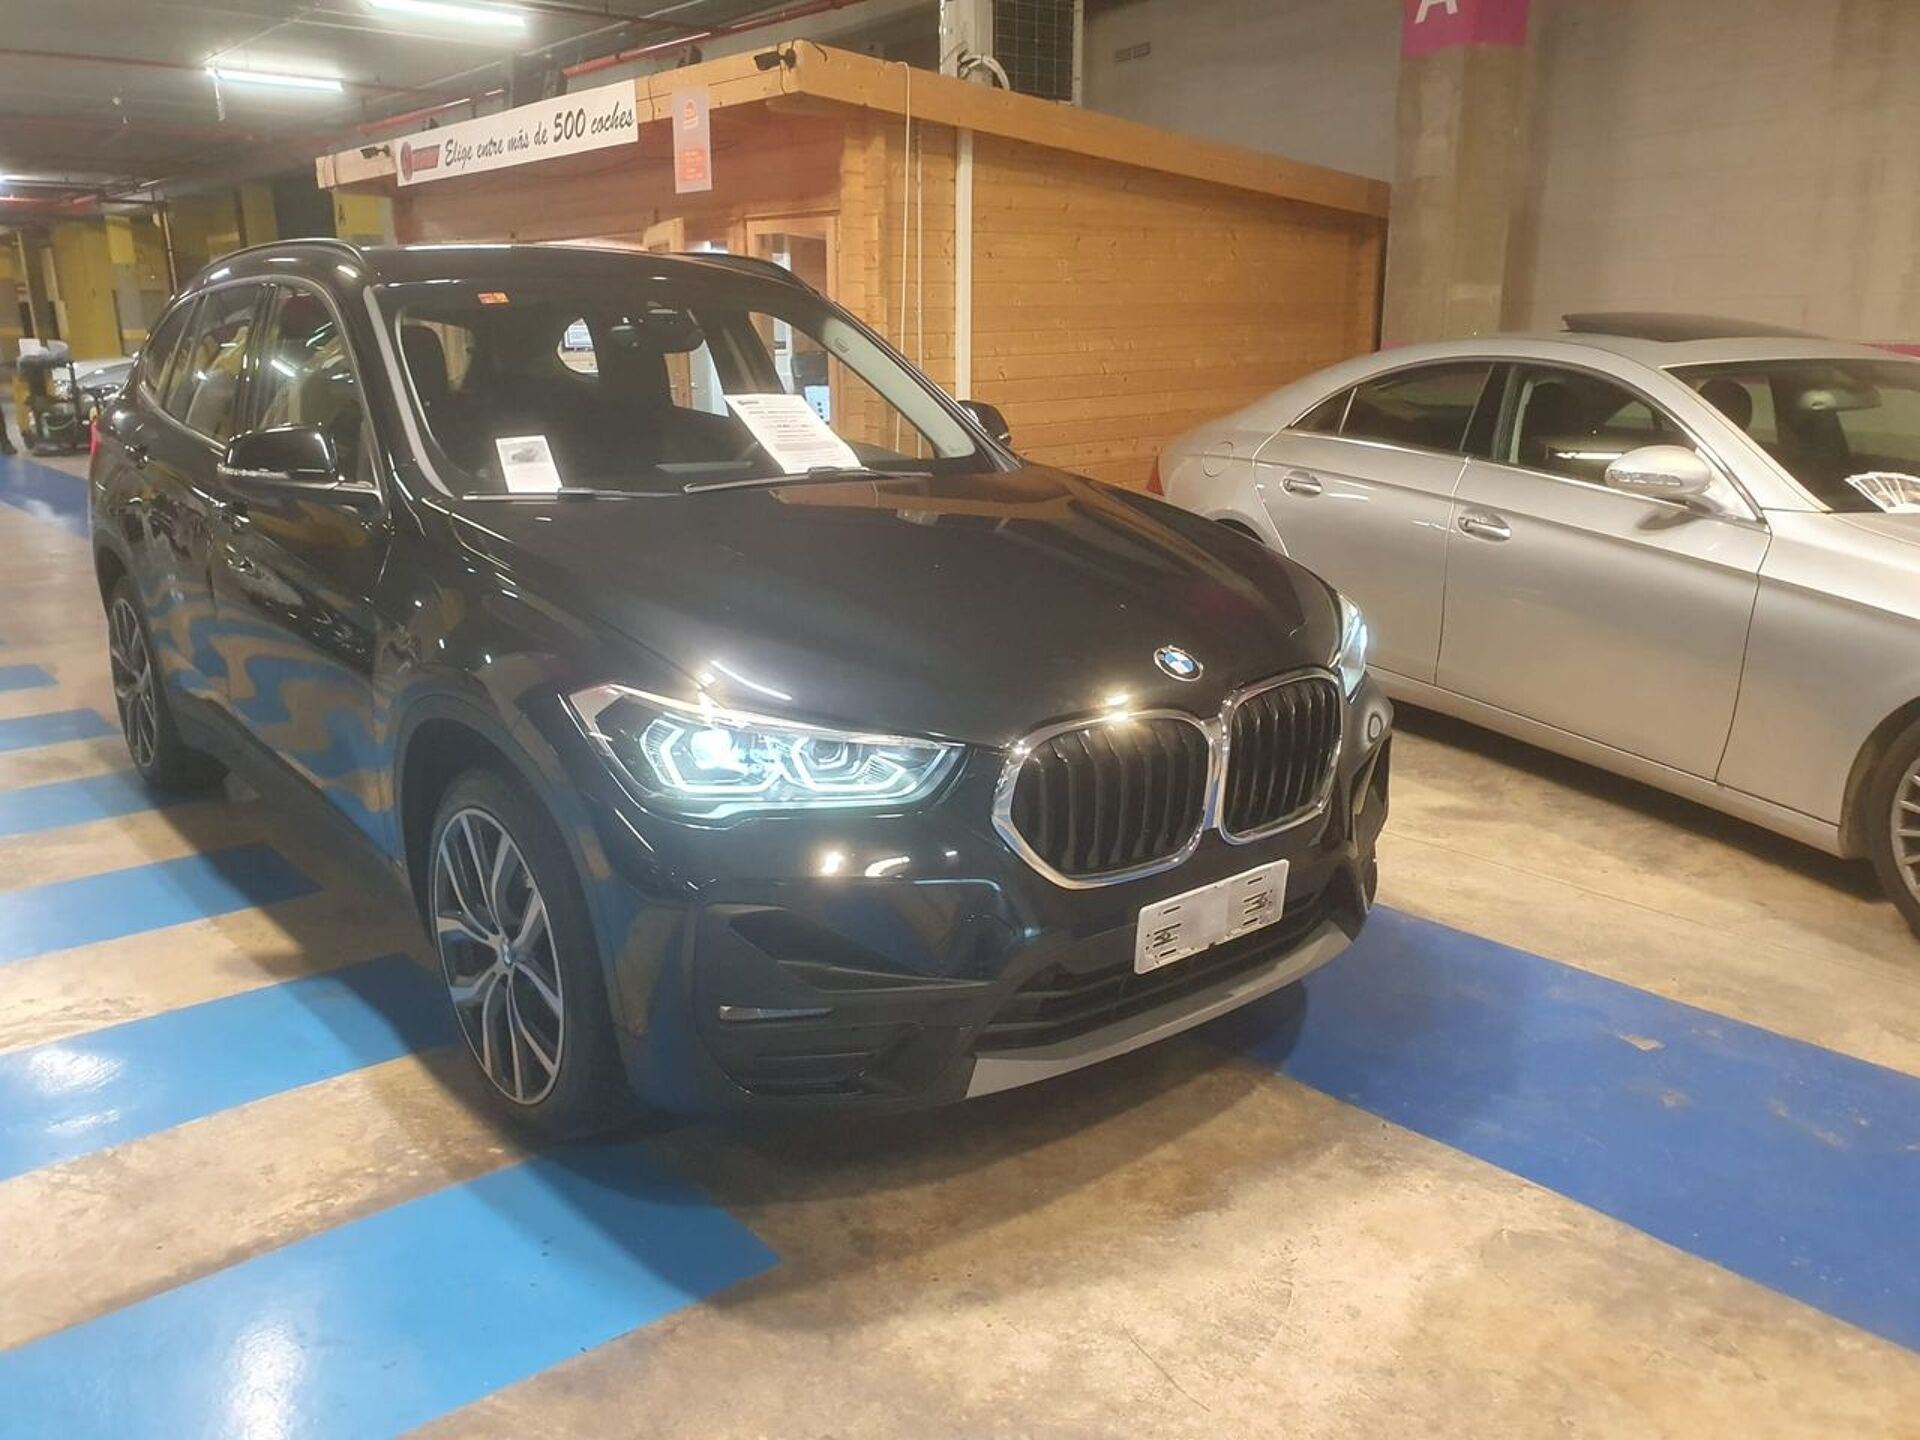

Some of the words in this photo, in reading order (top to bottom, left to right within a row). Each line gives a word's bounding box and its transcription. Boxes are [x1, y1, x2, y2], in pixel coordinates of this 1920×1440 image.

[445, 138, 472, 169] Elige
[477, 138, 504, 159] entre
[507, 129, 530, 151] más
[533, 121, 548, 145] de
[553, 107, 586, 143] 500
[591, 100, 633, 135] coches
